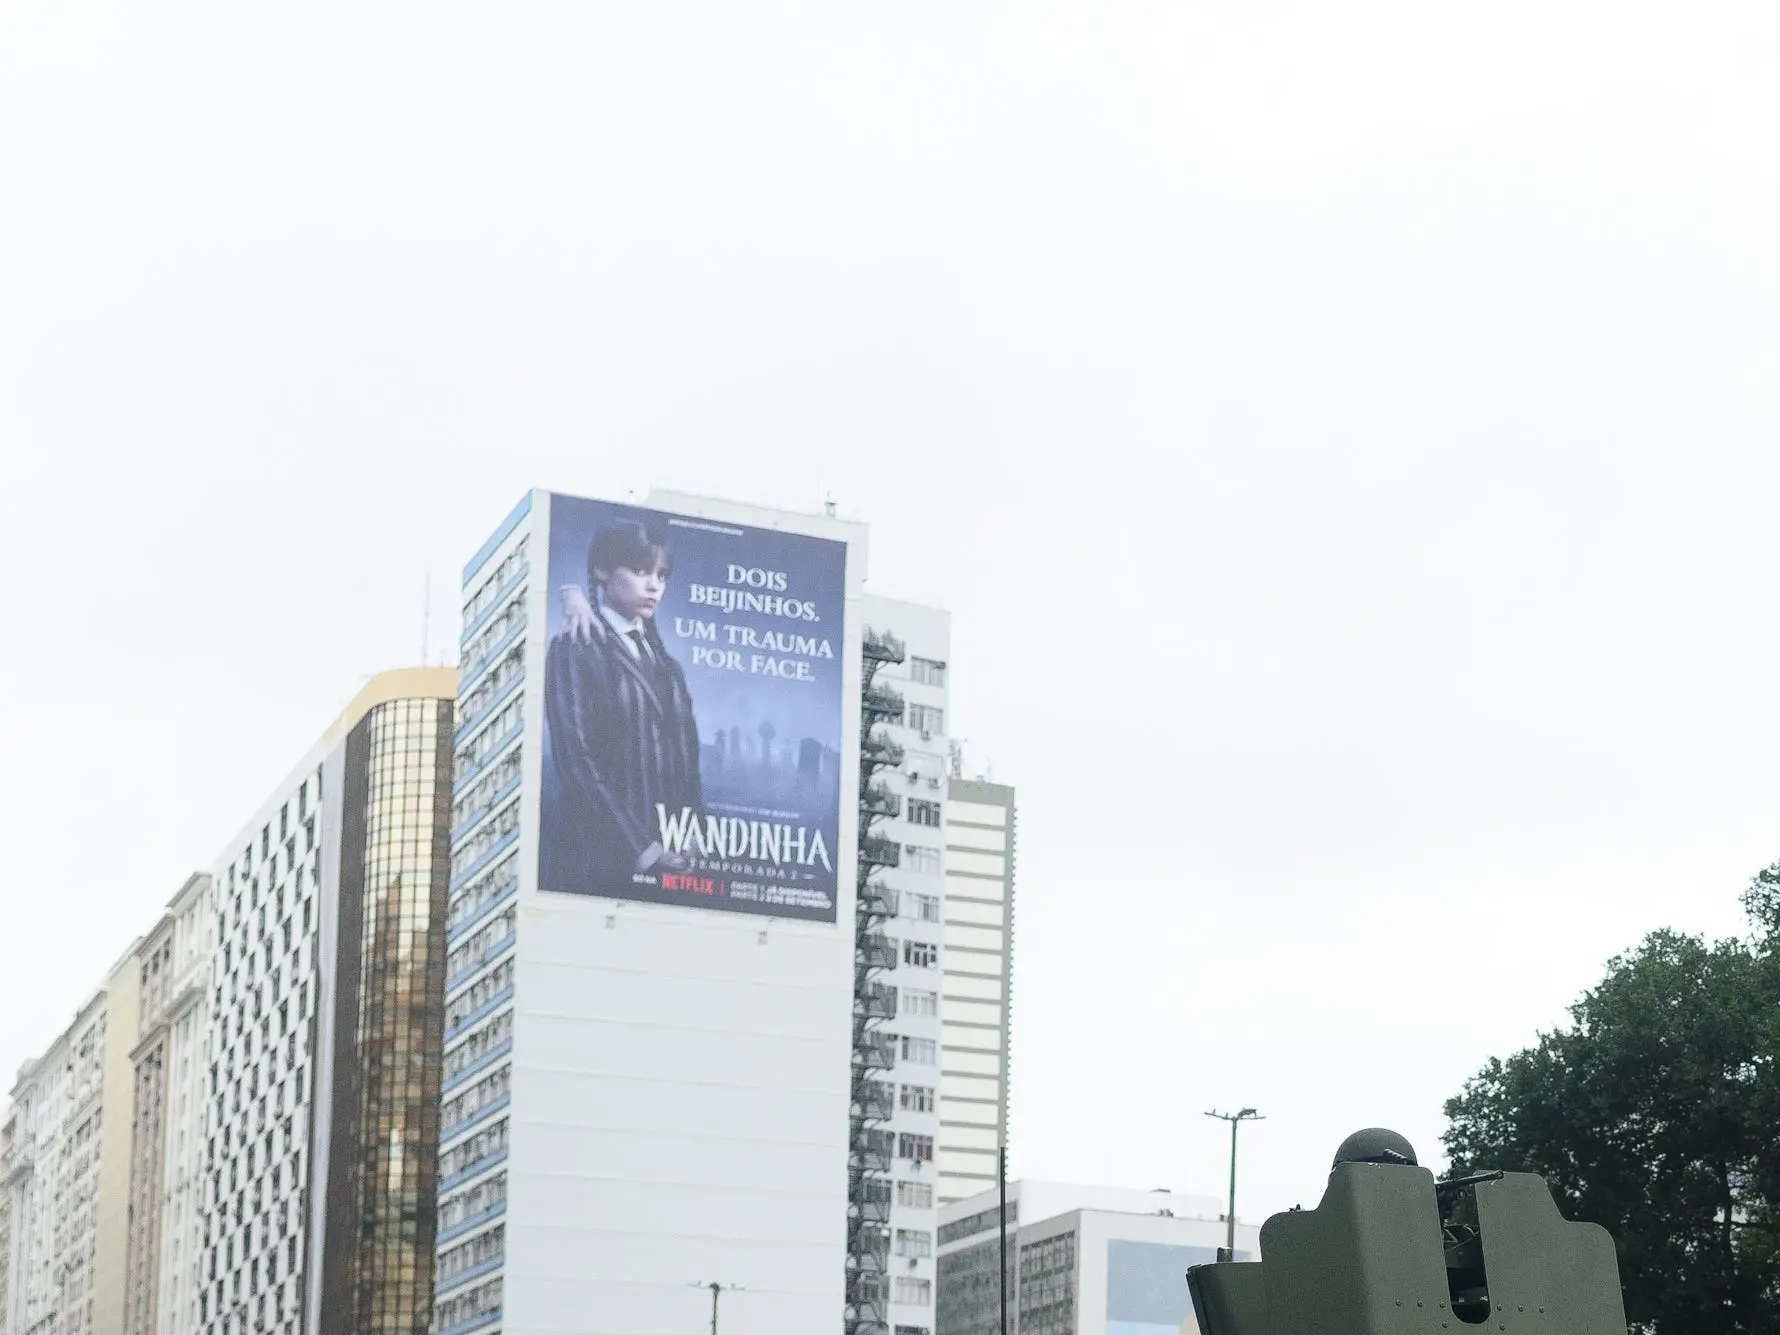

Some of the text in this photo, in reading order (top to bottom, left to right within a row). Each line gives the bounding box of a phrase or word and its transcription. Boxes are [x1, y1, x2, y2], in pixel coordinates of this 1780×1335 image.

[727, 564, 788, 592] DOIS
[690, 583, 820, 622] BEIJINHOS.
[675, 617, 834, 659] UM TRAUMA
[692, 646, 815, 682] POR FACE.
[655, 803, 833, 873] WANDINHA
[661, 872, 715, 896] NETFLIX
[689, 858, 786, 880] TEMPORADA
